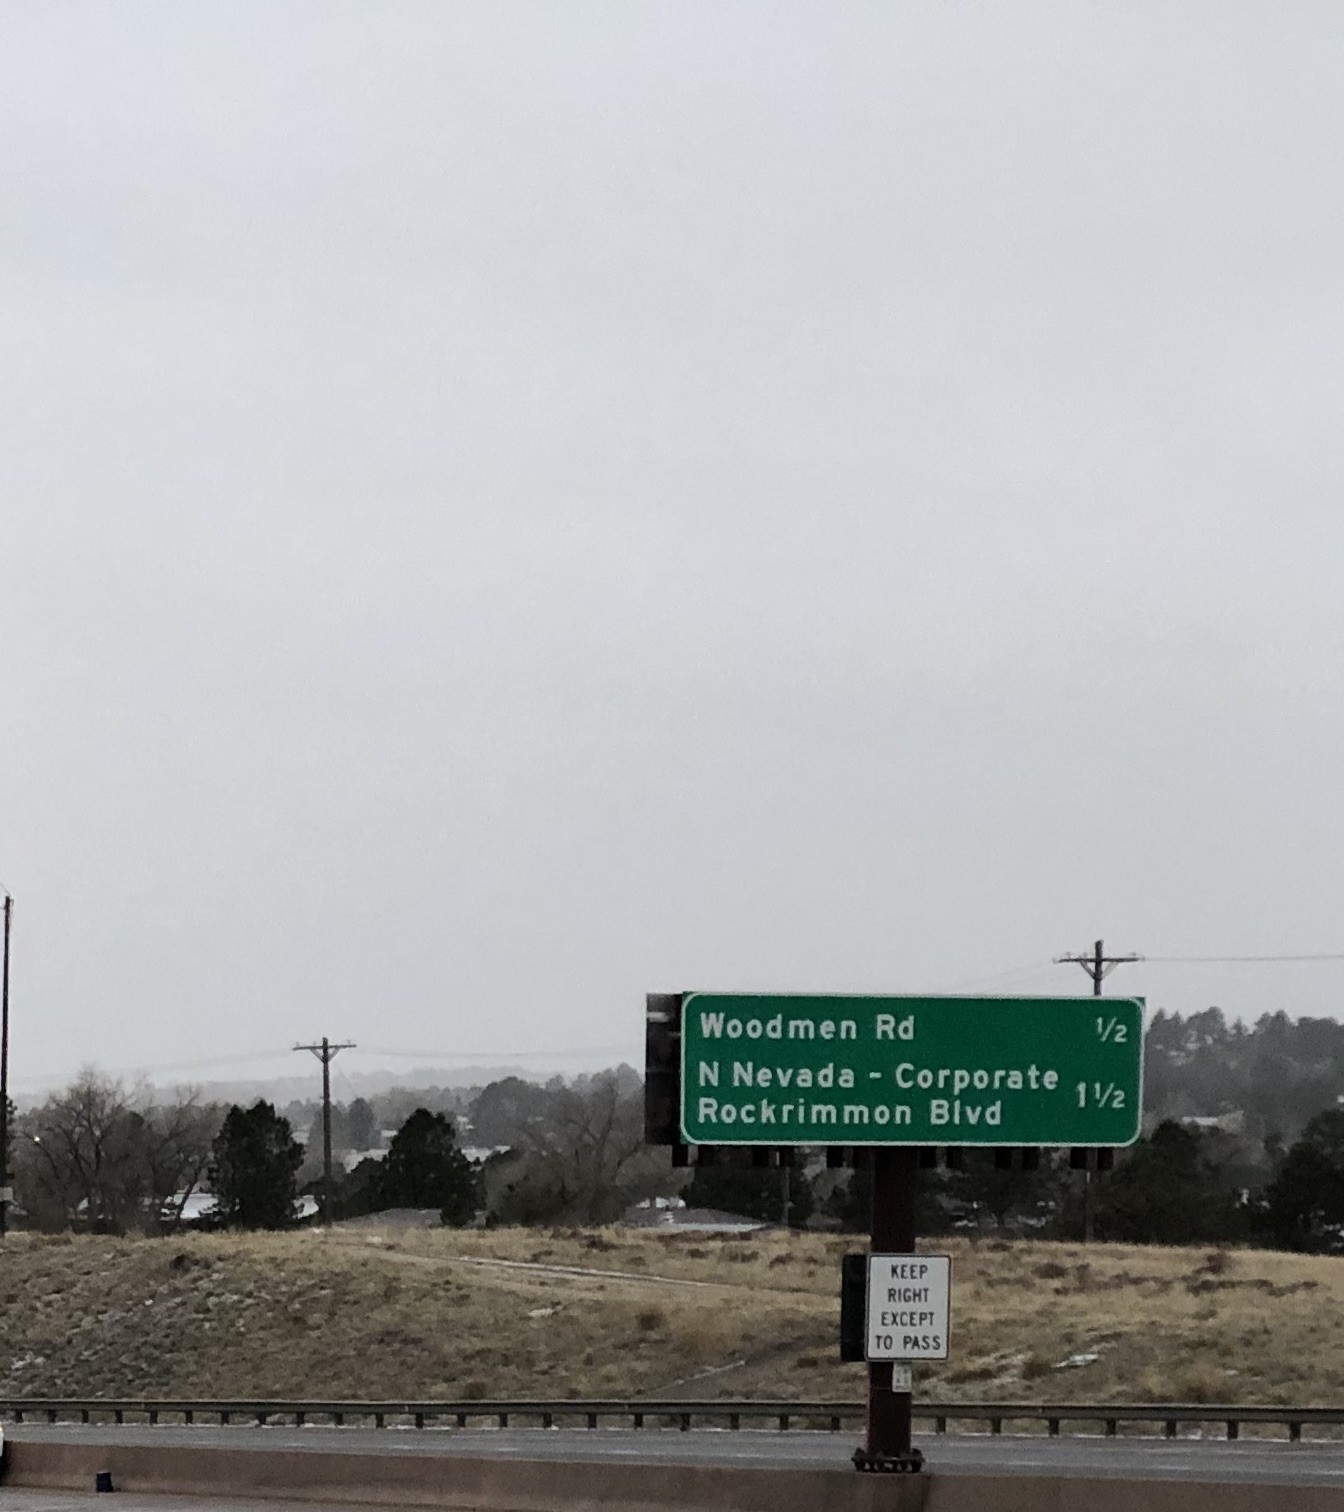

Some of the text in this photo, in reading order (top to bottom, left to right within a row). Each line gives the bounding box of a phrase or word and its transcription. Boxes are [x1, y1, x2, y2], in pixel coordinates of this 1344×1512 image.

[700, 1012, 857, 1040] Woodmen
[876, 1014, 915, 1040] Rd
[699, 1061, 720, 1087] N
[733, 1061, 855, 1088] Nevada
[895, 1063, 1059, 1096] Corporate
[698, 1097, 1002, 1125] Rockrimmon Blvd
[891, 1264, 928, 1279] KEEP
[888, 1288, 929, 1302] RIGHT
[881, 1311, 935, 1327] EXCEPT
[876, 1335, 941, 1350] TO PASS
